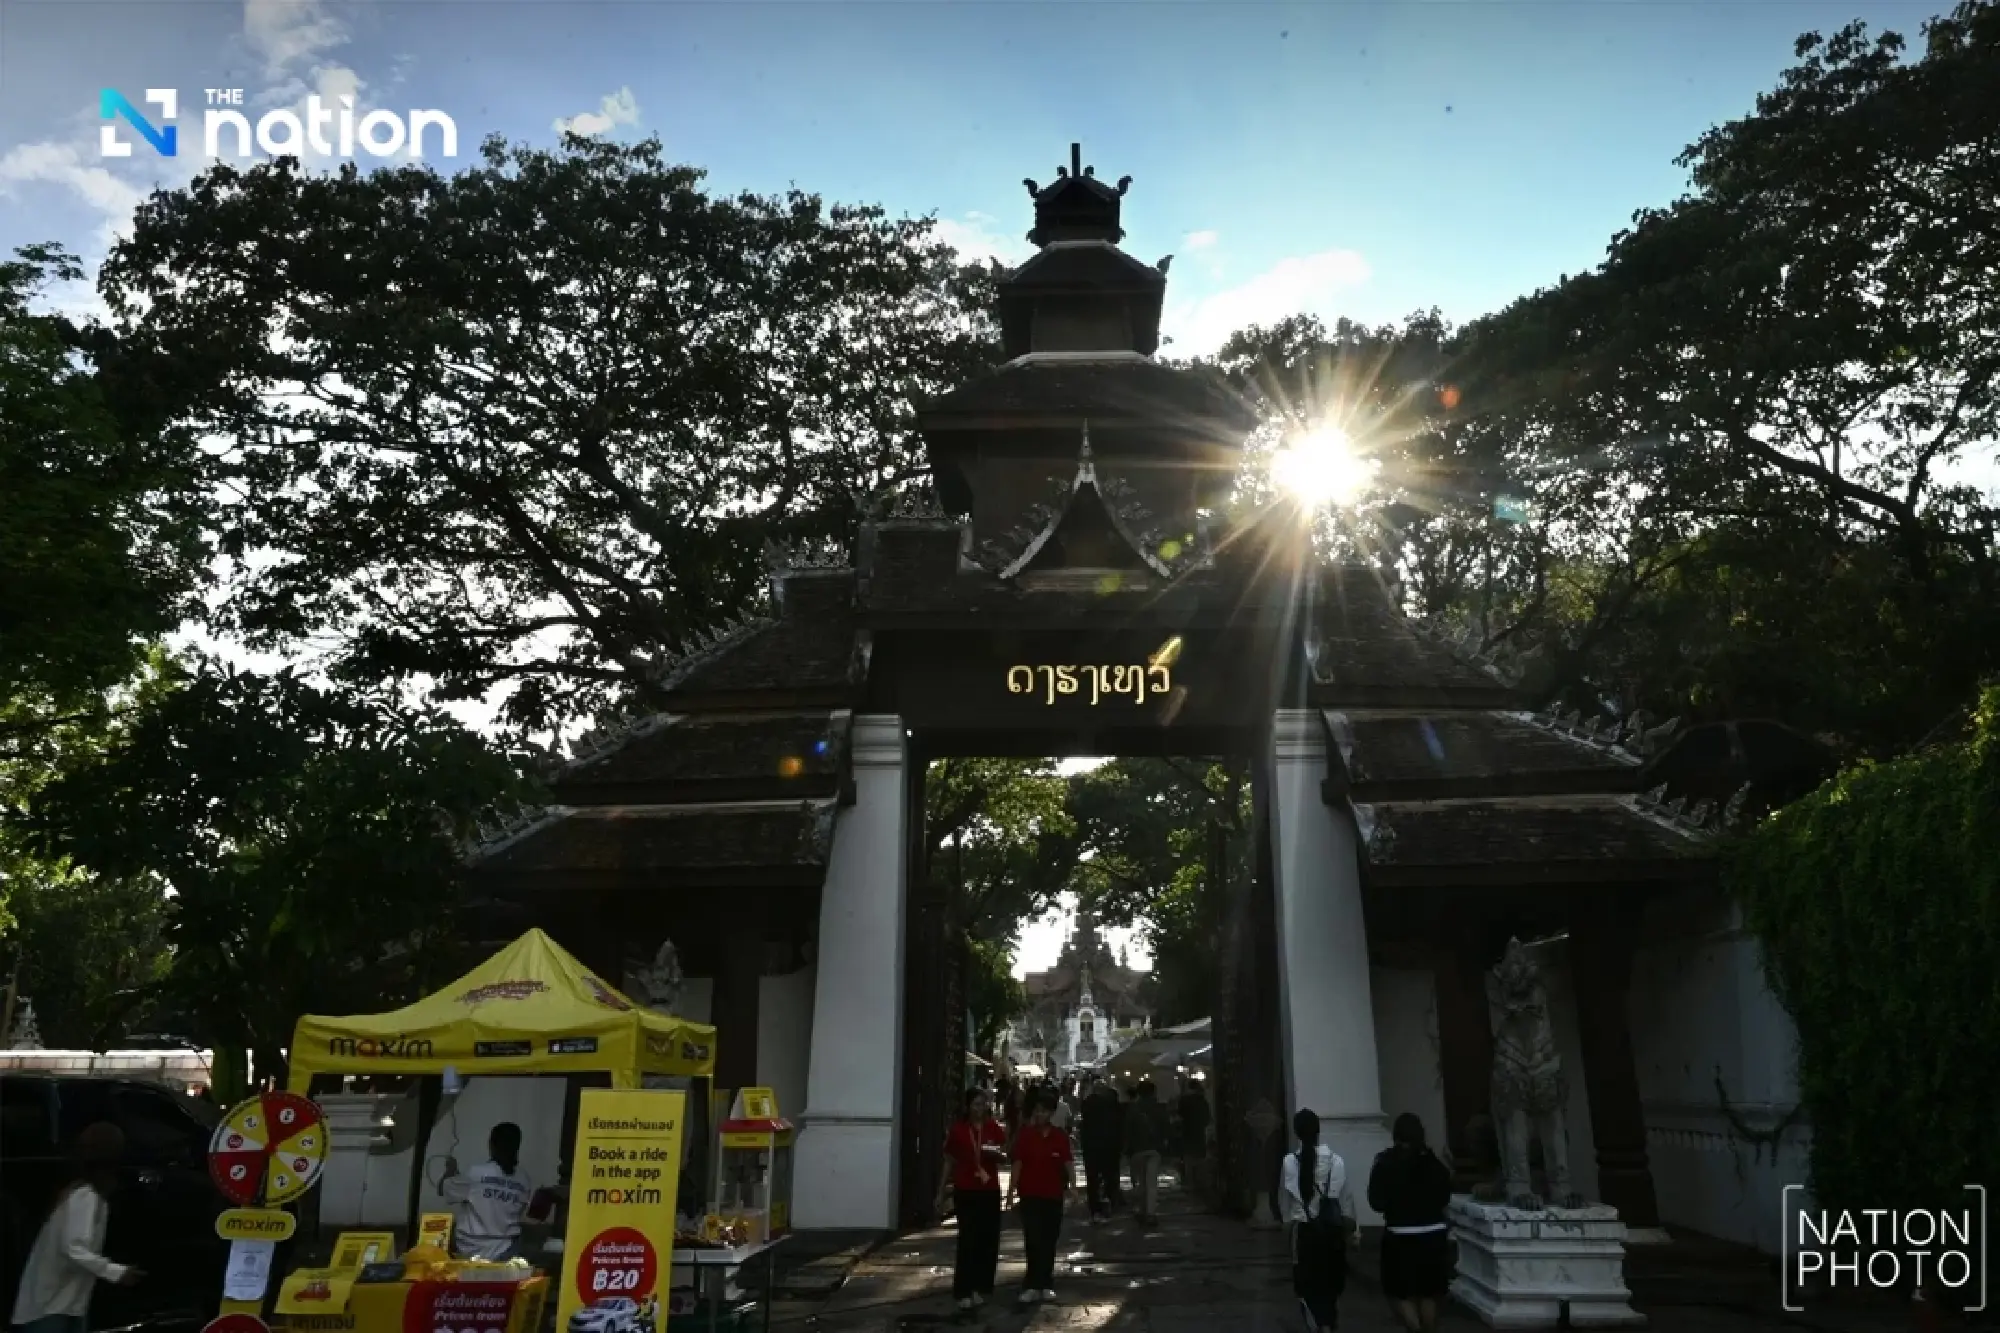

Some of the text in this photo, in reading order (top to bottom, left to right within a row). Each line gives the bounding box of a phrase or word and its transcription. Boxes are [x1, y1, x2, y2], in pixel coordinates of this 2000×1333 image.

[329, 1033, 433, 1058] maxim
[588, 1146, 668, 1161] Book a ride
[592, 1165, 661, 1181] in the app
[587, 1183, 661, 1204] maxim
[226, 1216, 286, 1232] maxim
